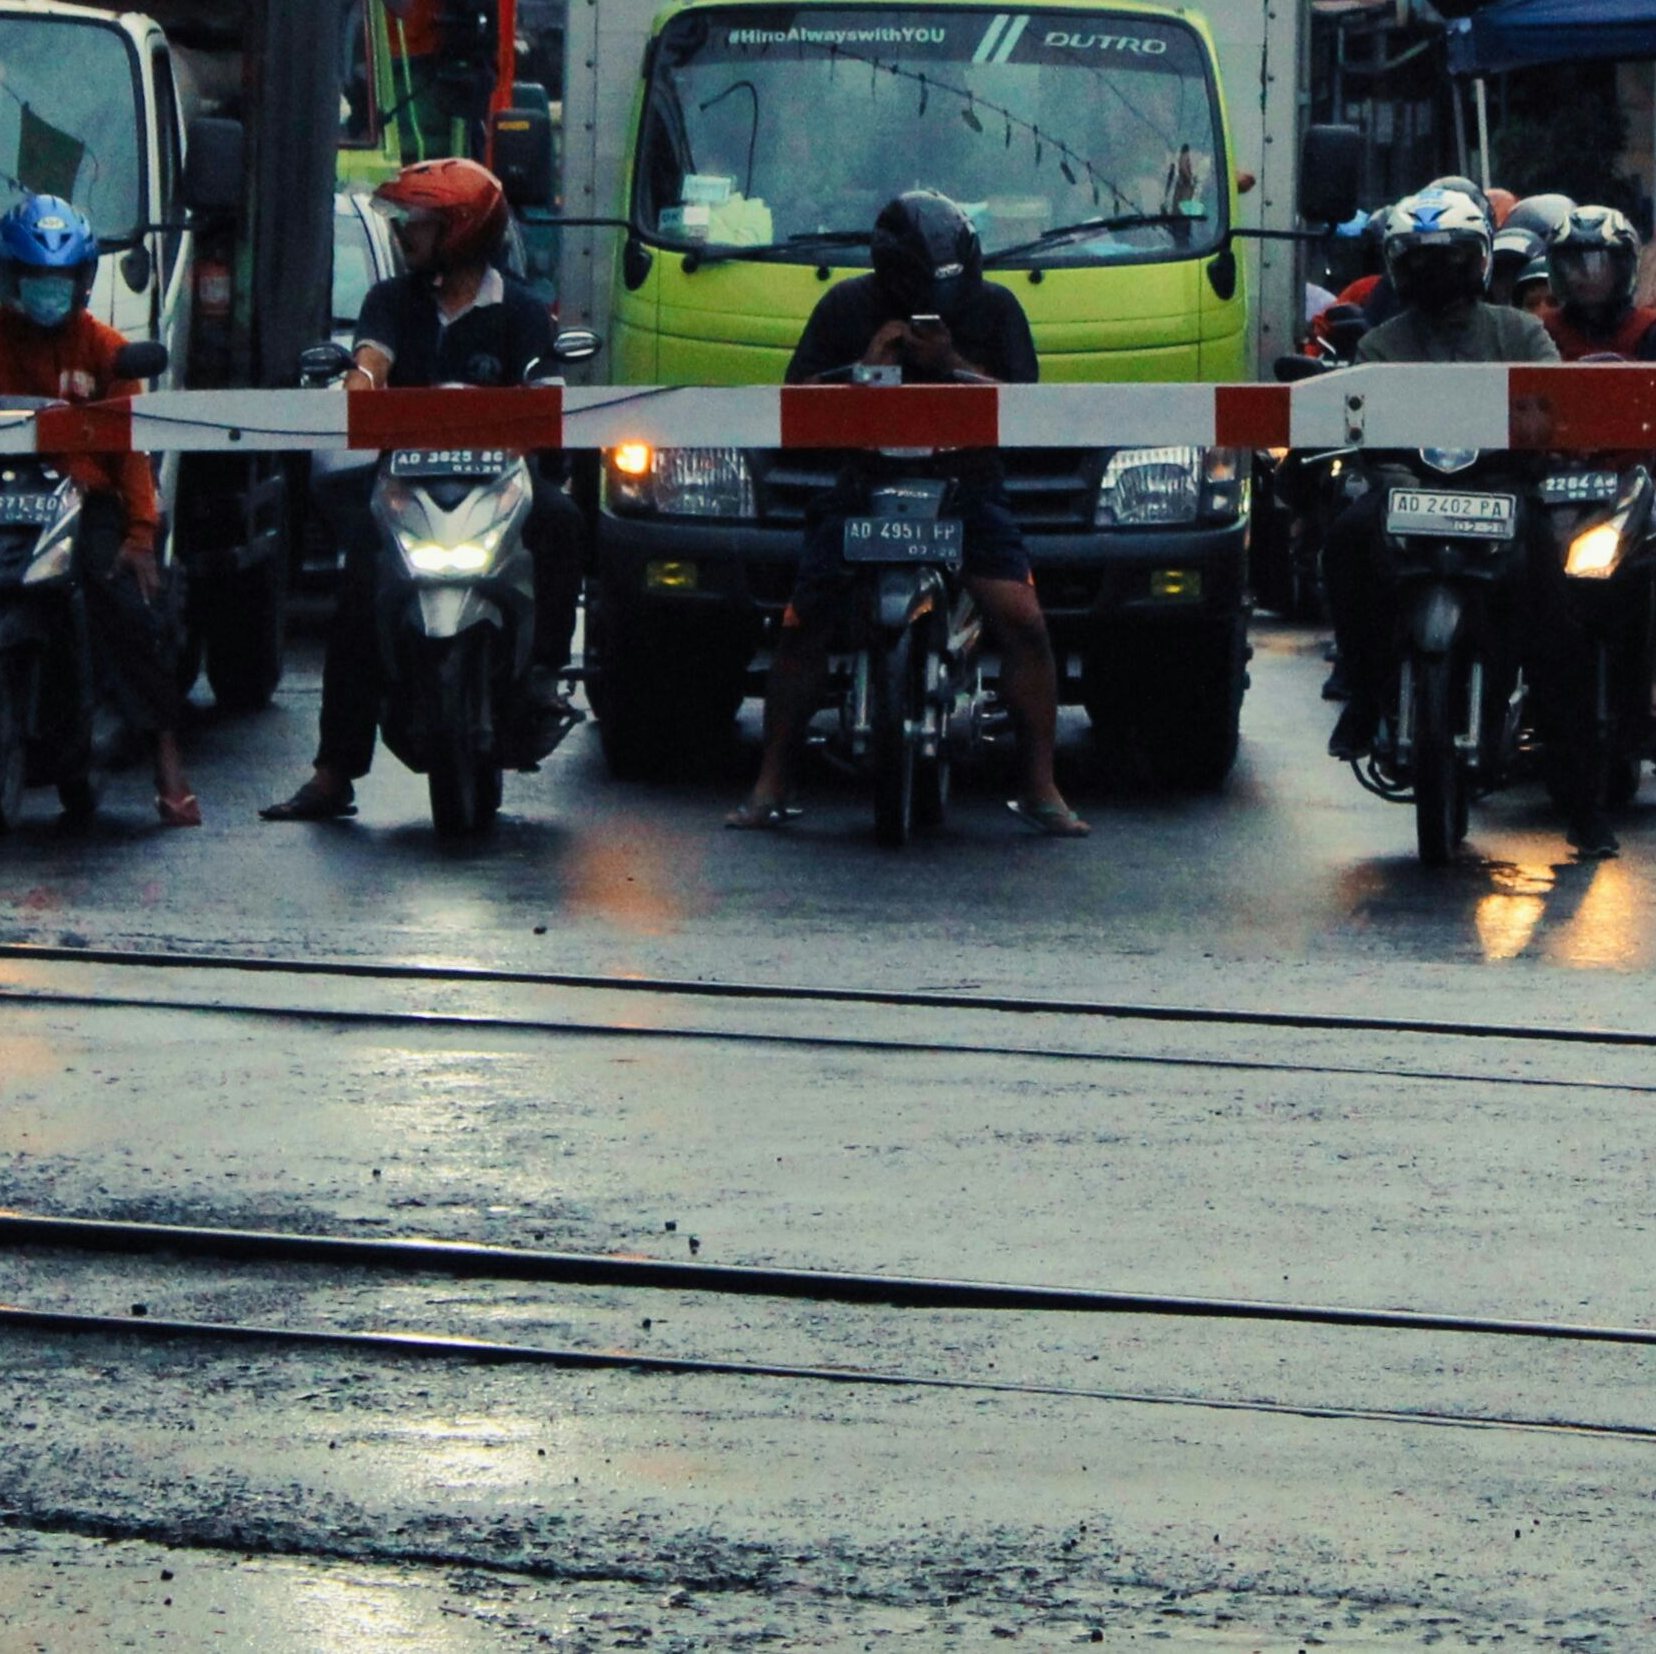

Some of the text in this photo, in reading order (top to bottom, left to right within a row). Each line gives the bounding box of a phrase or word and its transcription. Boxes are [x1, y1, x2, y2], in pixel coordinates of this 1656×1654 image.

[729, 26, 945, 44] #HinoAlwayswithYOU
[1045, 31, 1167, 55] DUTRO
[1397, 496, 1502, 517] AD 2402 PA
[850, 522, 871, 539] AD
[880, 522, 922, 539] 4951
